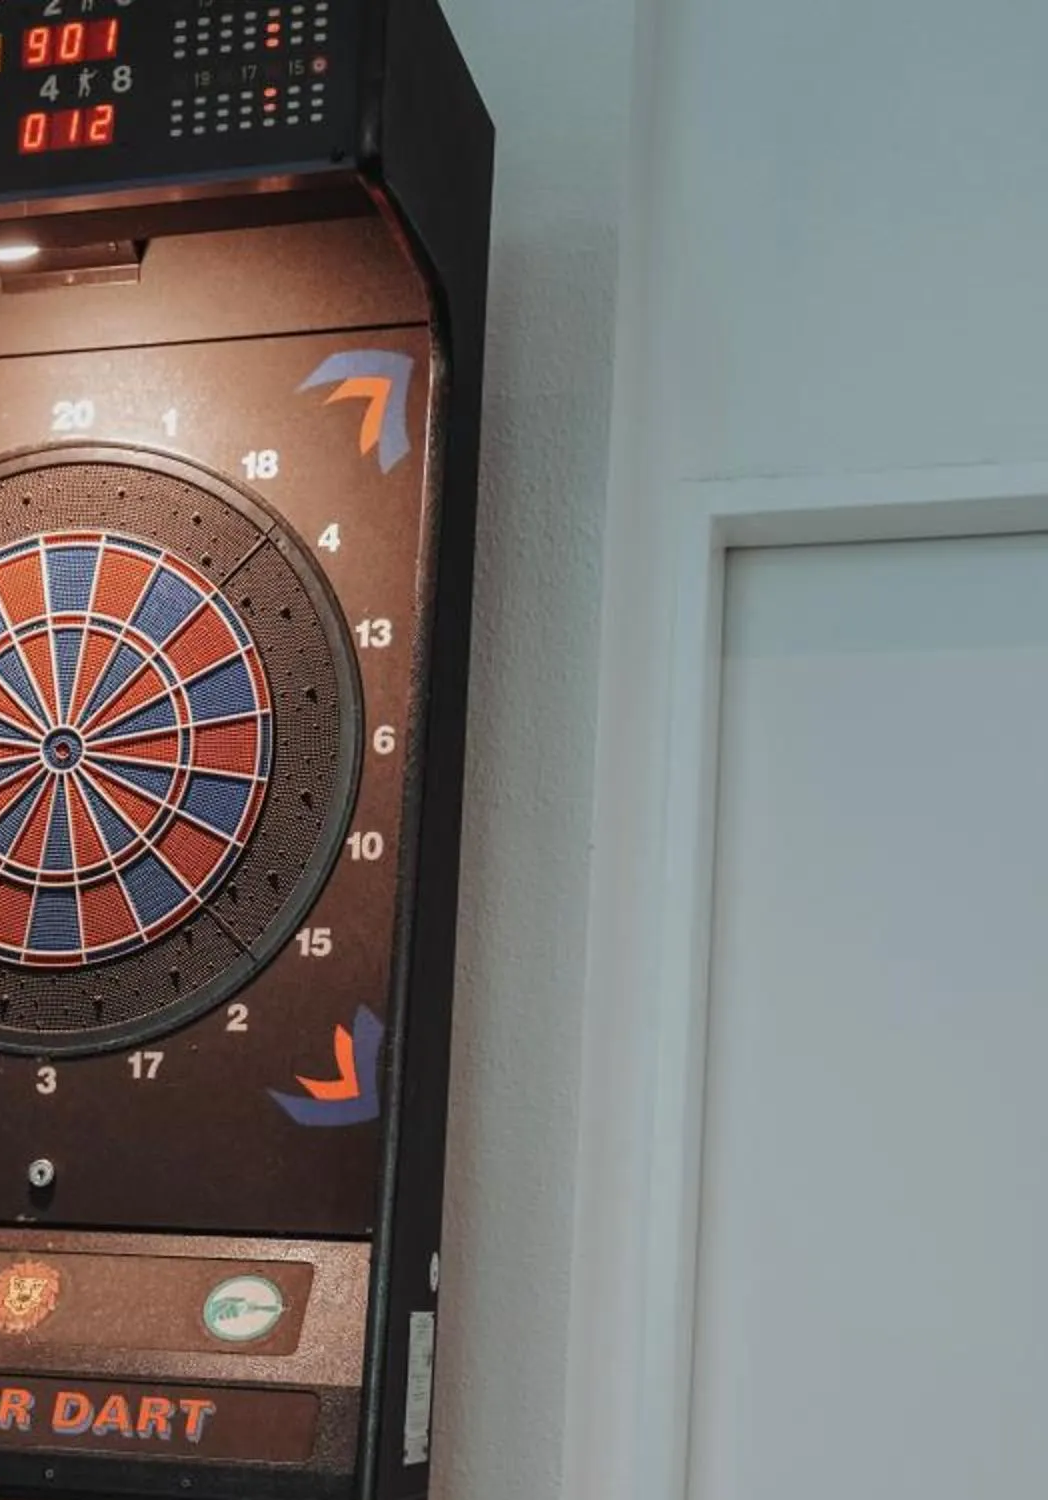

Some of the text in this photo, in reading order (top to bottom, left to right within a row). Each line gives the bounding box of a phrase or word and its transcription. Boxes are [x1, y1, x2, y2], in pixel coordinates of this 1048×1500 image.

[26, 20, 119, 65] 901
[39, 66, 133, 101] 4 8
[22, 105, 114, 149] 012
[56, 401, 94, 429] 20
[163, 409, 177, 437] 1
[242, 450, 278, 479] 18
[318, 524, 341, 552] 4
[356, 619, 392, 648] 13
[373, 726, 395, 755] 6
[347, 831, 384, 861] 10
[295, 927, 332, 957] 15
[227, 1003, 248, 1031] 2
[128, 1051, 164, 1079] 17
[36, 1066, 57, 1094] 3
[51, 1391, 216, 1444] DART
